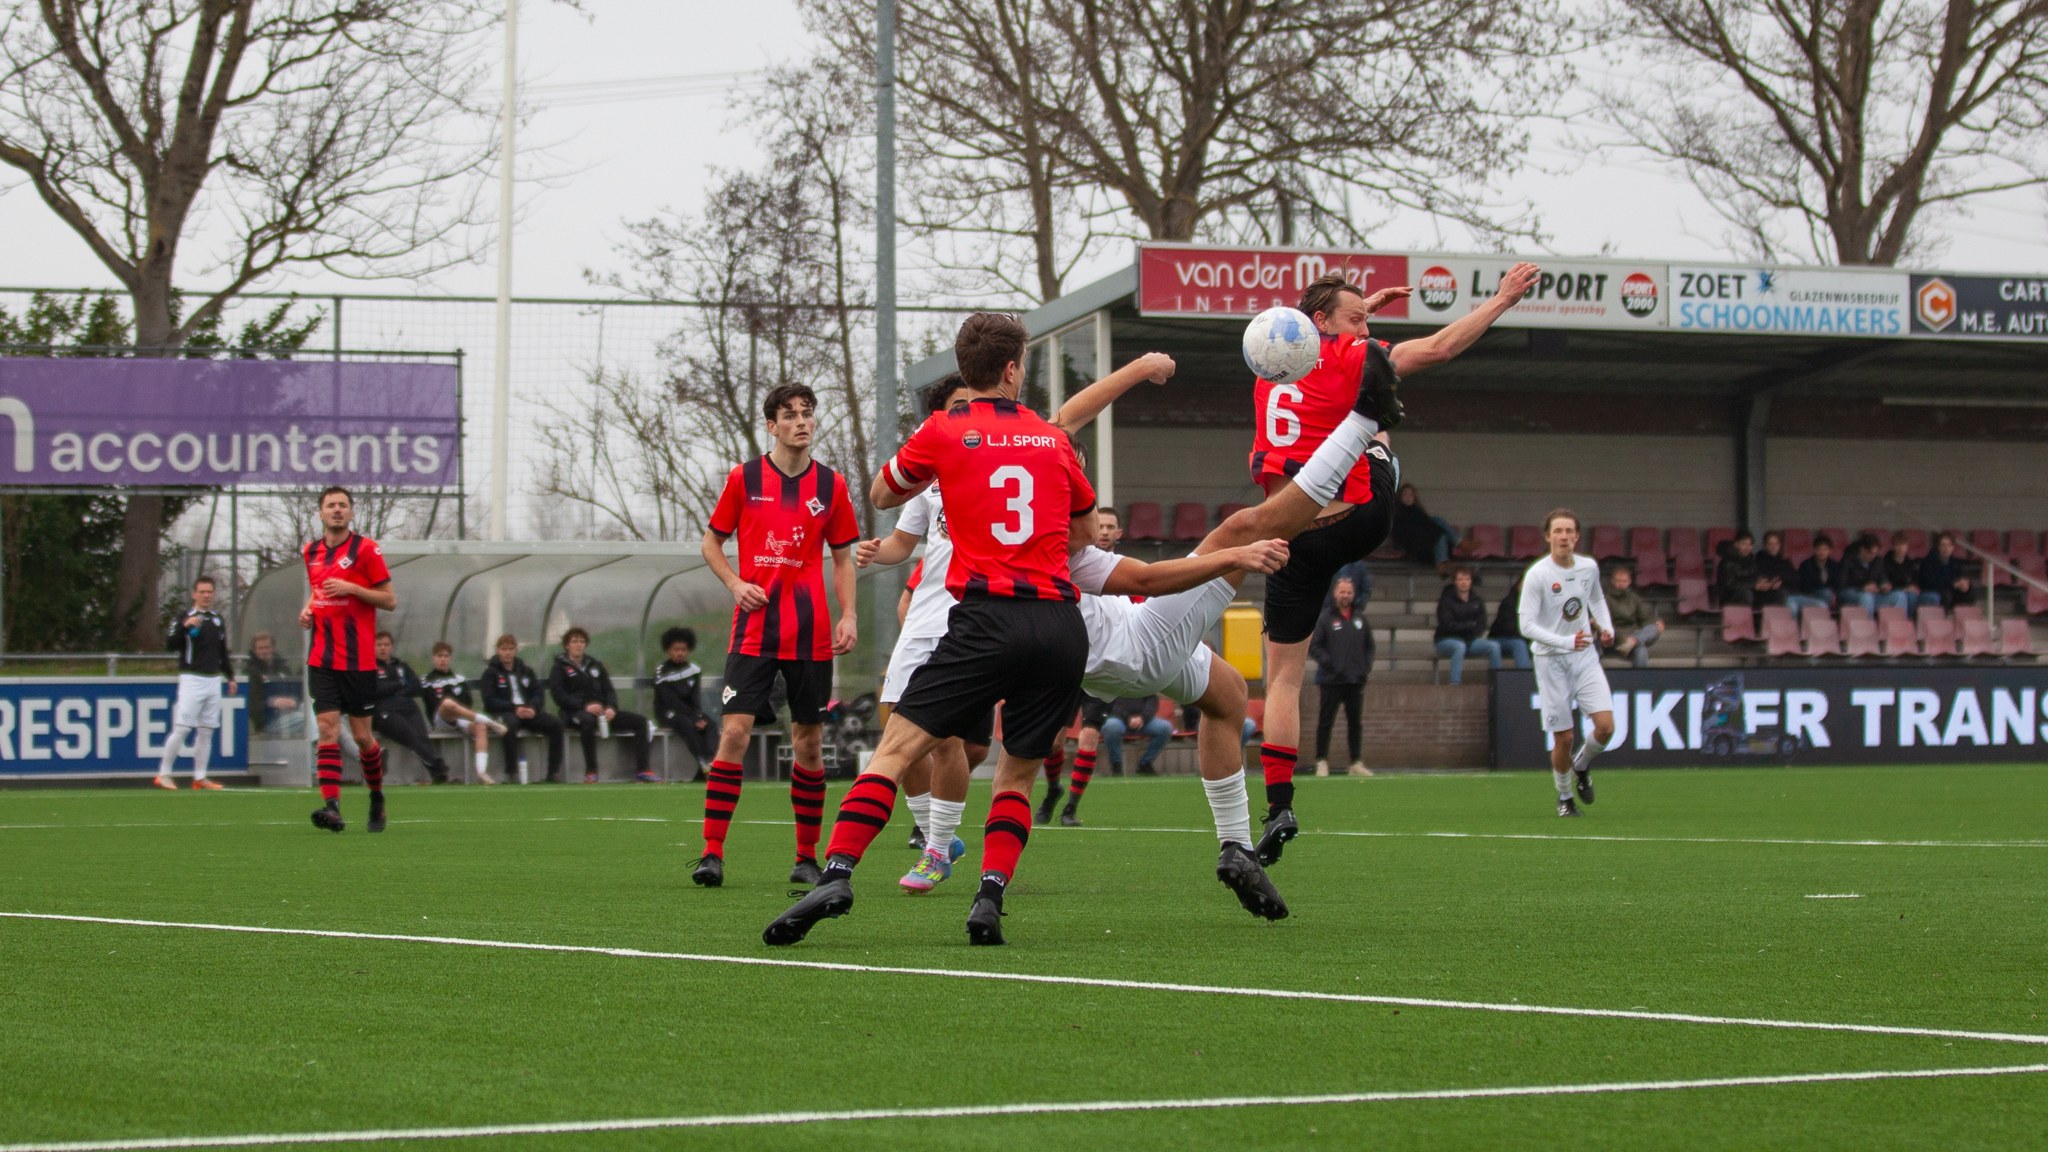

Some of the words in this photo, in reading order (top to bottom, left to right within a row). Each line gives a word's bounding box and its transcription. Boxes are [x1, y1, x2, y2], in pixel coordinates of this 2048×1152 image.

[1175, 261, 1234, 288] van
[1238, 254, 1292, 290] der
[1422, 276, 1453, 289] SPORT
[1424, 290, 1454, 304] 2000
[1623, 282, 1654, 297] SPORT
[1680, 273, 1747, 299] ZOET
[1560, 305, 1607, 317] sportshop
[1626, 296, 1655, 311] 2000
[1680, 302, 1901, 334] SCHOONMAKERS
[1961, 311, 2001, 333] M.E.
[2008, 312, 2048, 333] AUT
[1266, 383, 1303, 447] 6
[50, 425, 441, 474] accountants
[987, 434, 1011, 447] L.J.
[1013, 435, 1056, 449] SPORT
[989, 465, 1034, 546] 3
[0, 697, 246, 760] ESPET
[1850, 687, 2048, 748] TRAN
